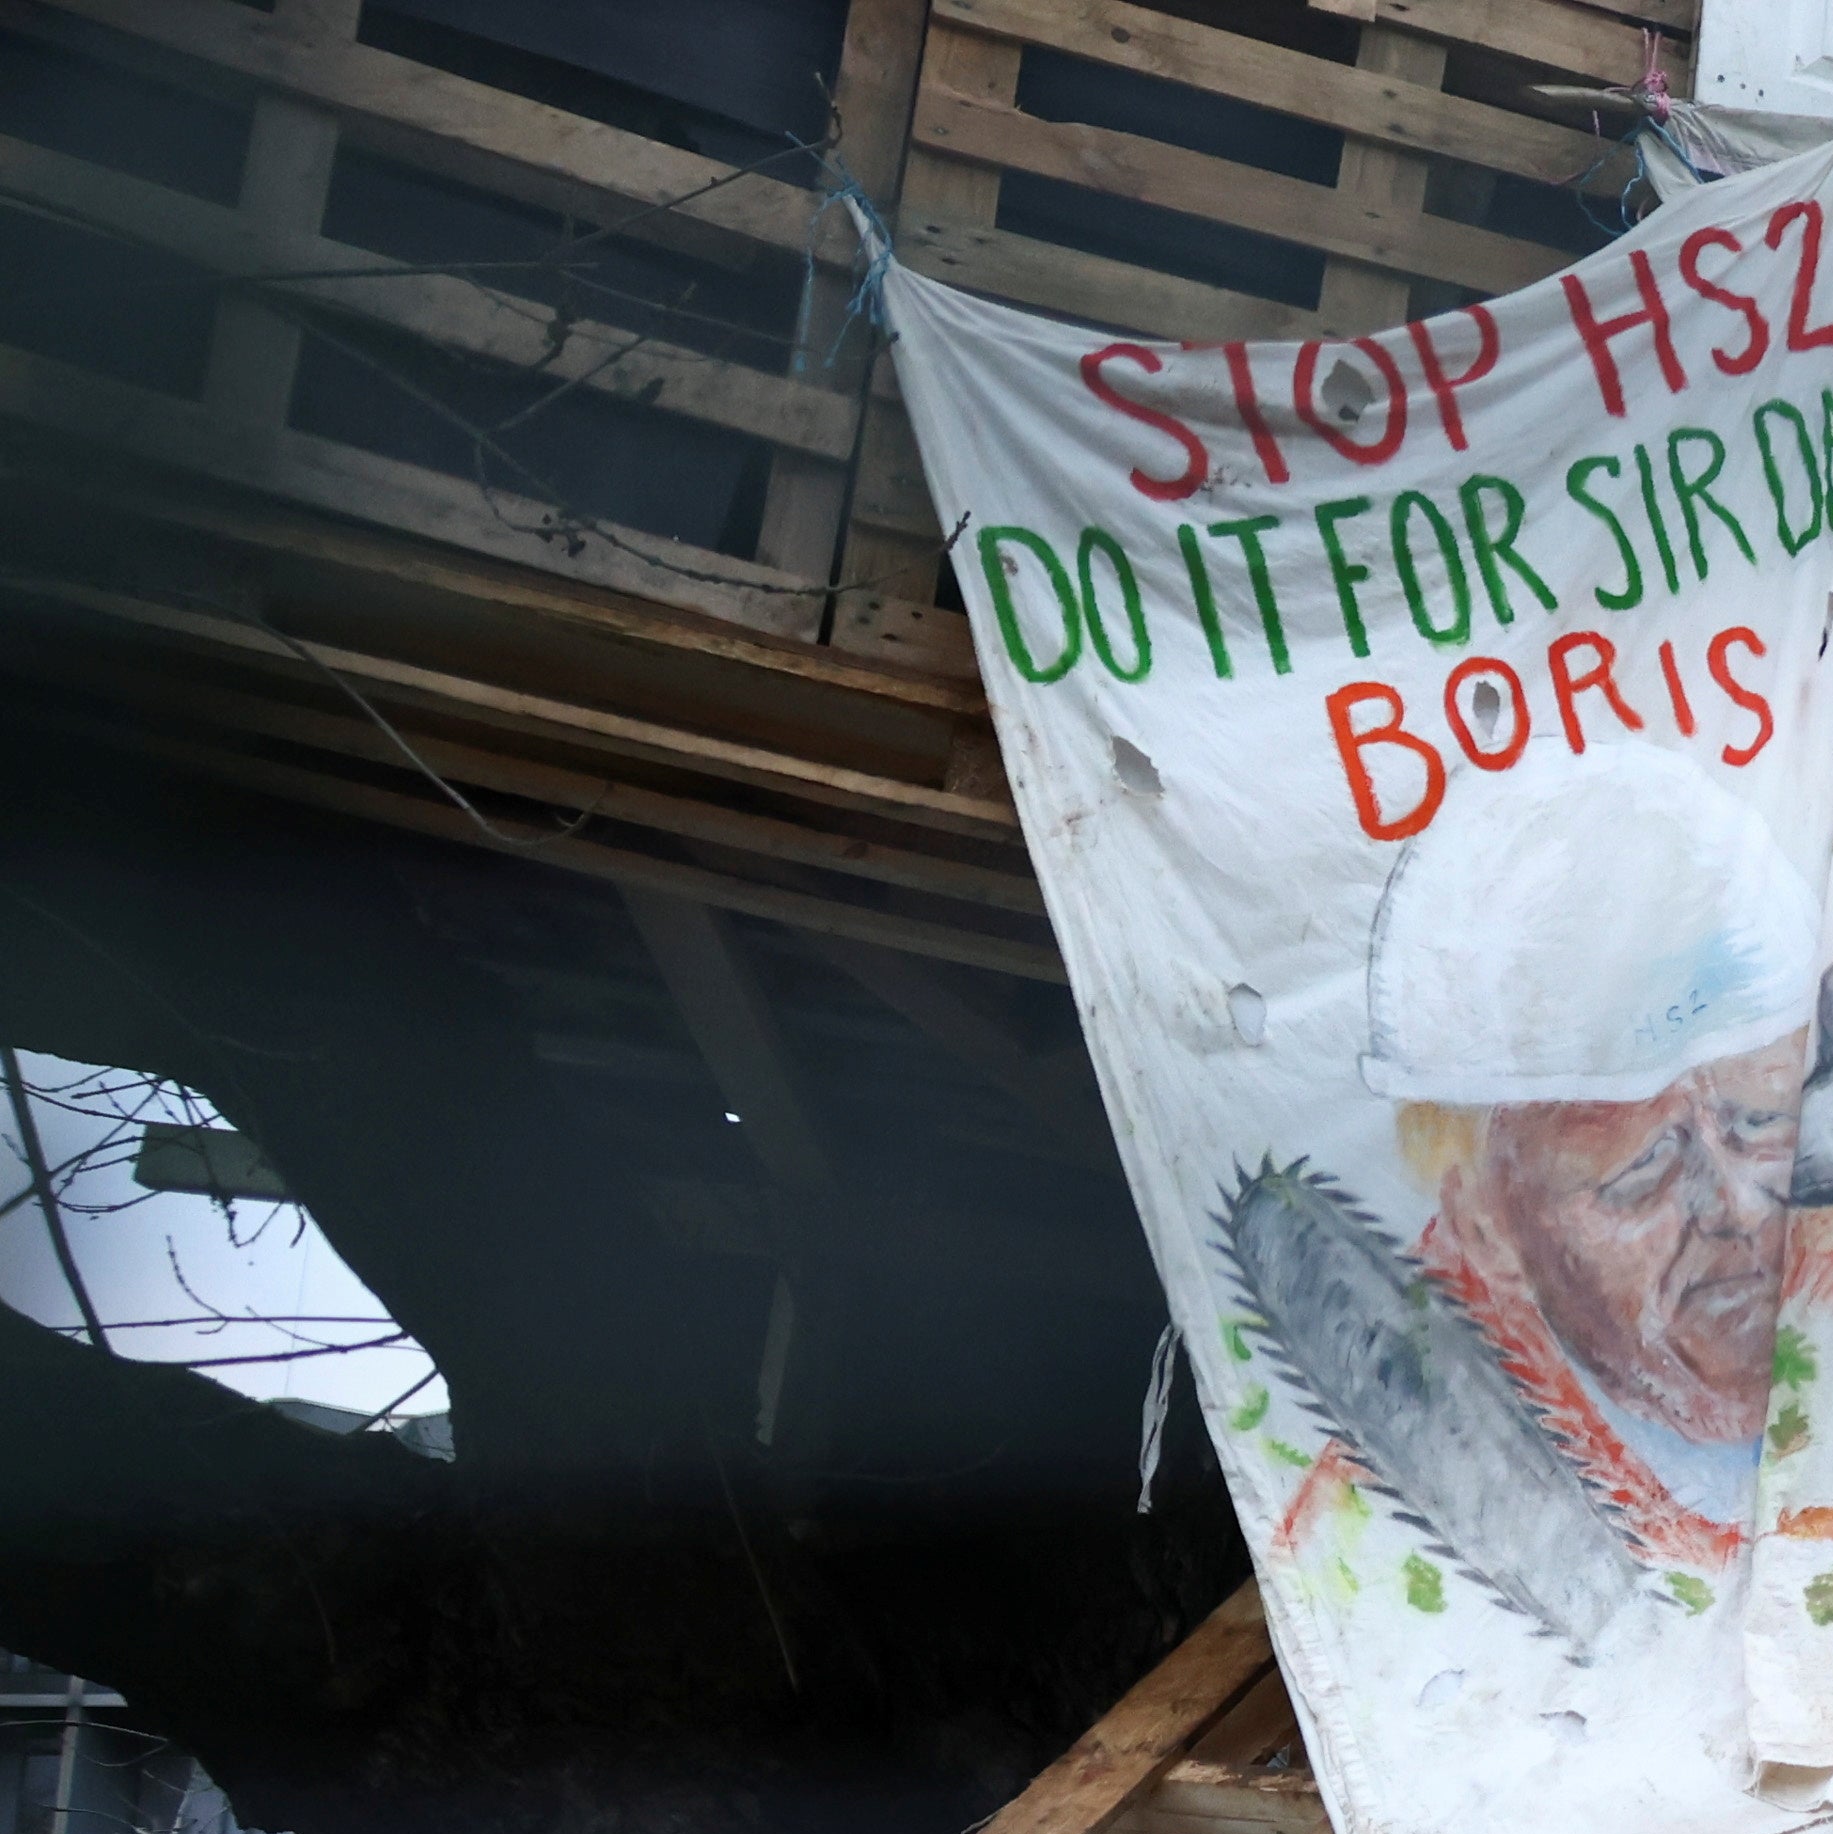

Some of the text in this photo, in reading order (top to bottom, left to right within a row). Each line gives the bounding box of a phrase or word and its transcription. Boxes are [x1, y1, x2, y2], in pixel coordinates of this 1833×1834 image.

[1080, 302, 1500, 502] STOP
[980, 523, 1153, 684] DO
[1177, 513, 1292, 679] IT
[1316, 472, 1558, 658] FOR
[1566, 427, 1757, 611] SIR
[1325, 625, 1774, 844] BORIS
